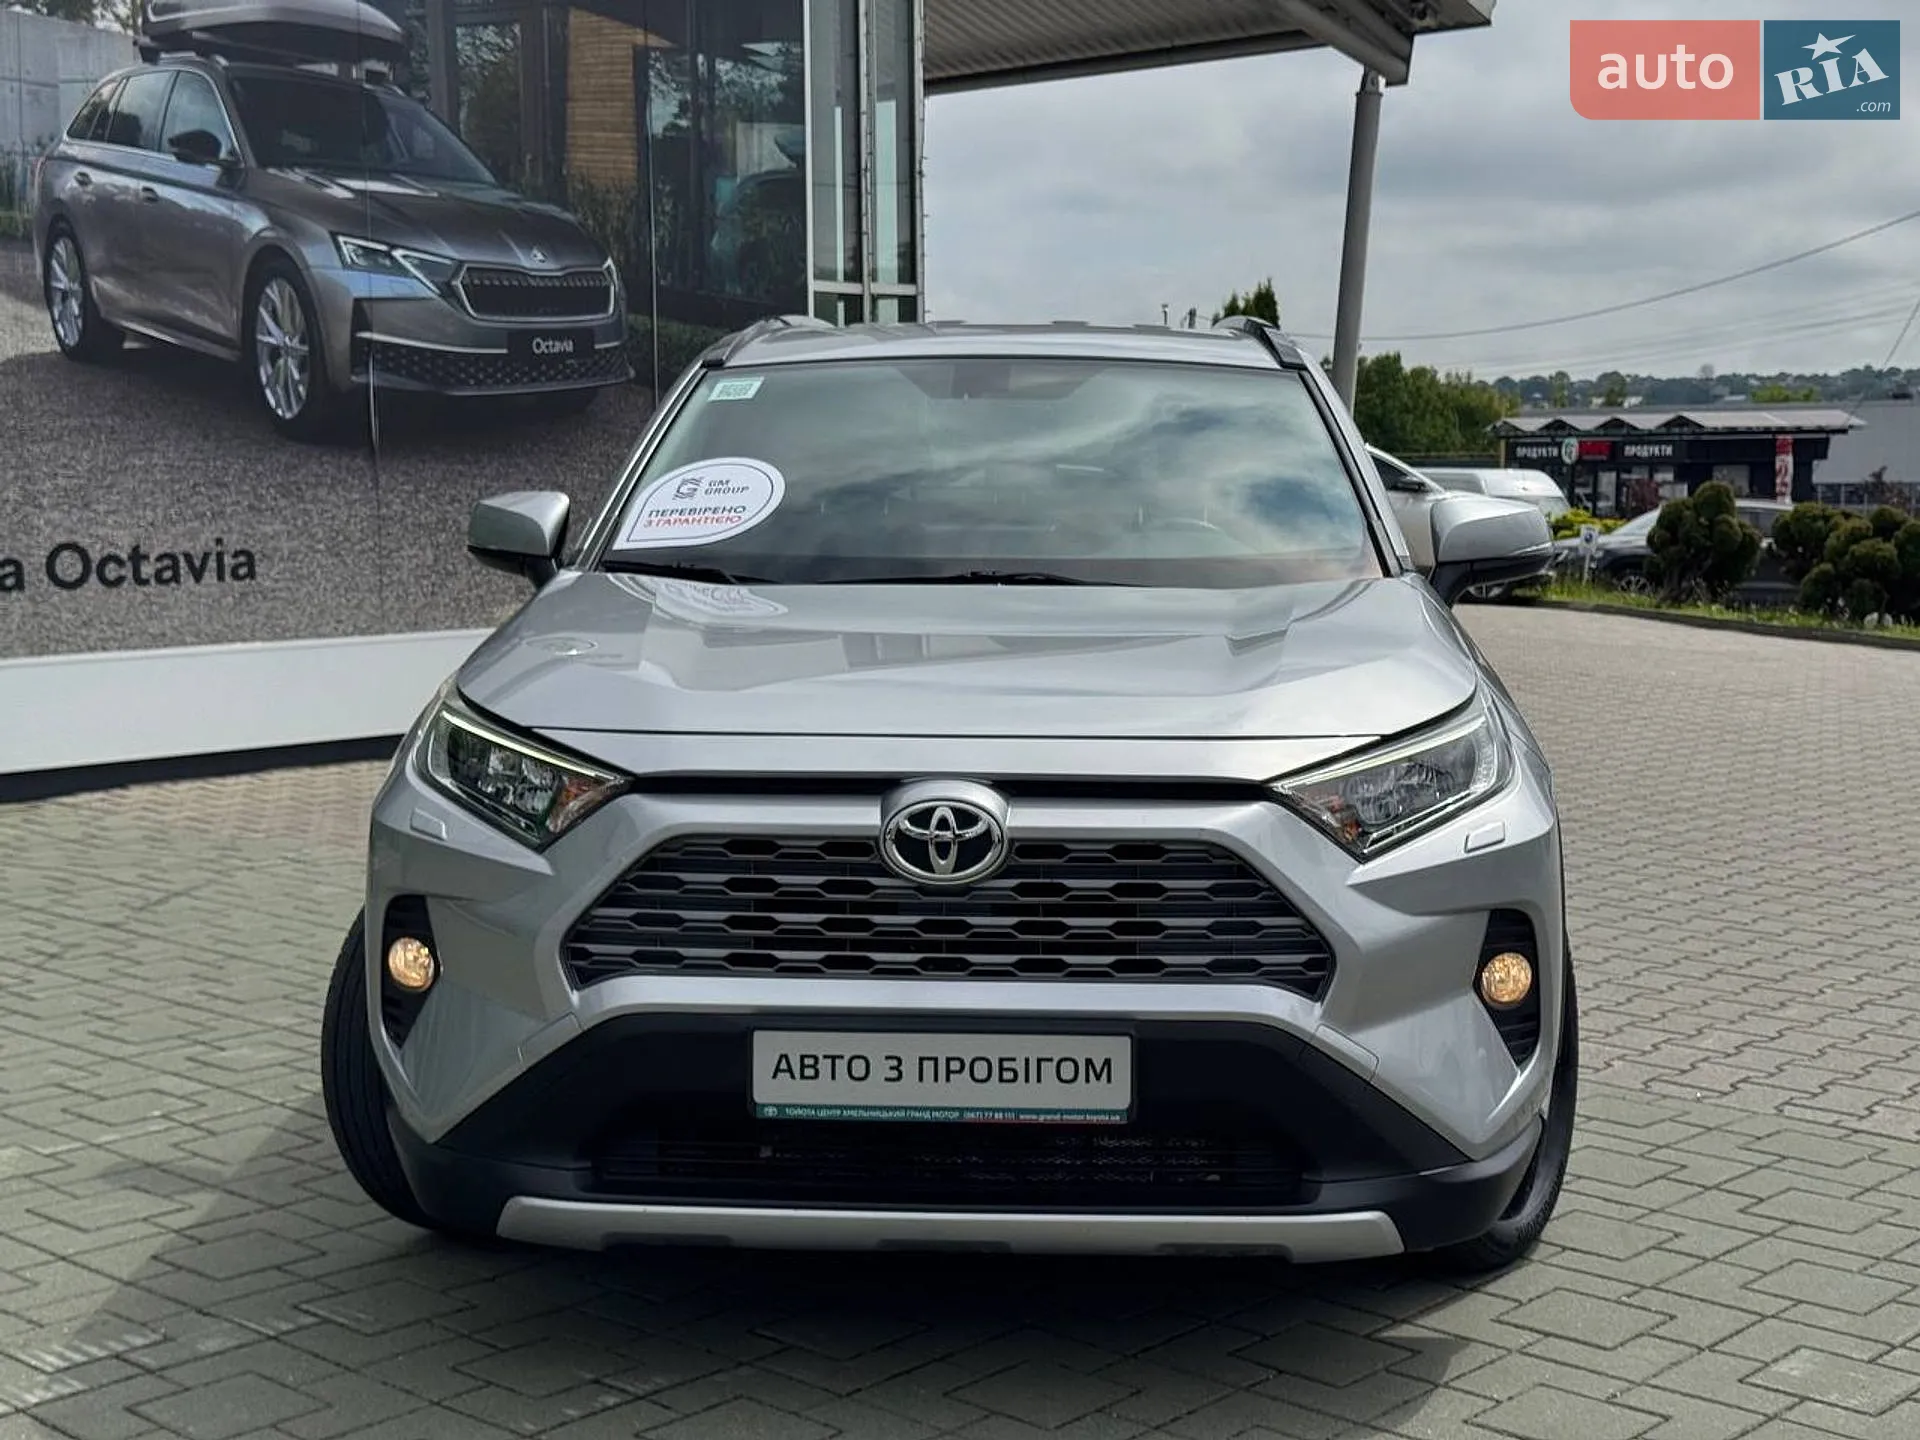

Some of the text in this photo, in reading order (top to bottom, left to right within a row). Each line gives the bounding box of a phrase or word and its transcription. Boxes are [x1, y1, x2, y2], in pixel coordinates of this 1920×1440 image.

[532, 337, 574, 354] Octavia
[1516, 447, 1559, 458] ПРОДУКТИ
[1624, 444, 1673, 457] ПРОДУКТИ
[704, 486, 750, 496] GROUP
[649, 505, 747, 518] ПЕРЕВІРЕНО
[46, 537, 256, 590] Octavia
[771, 1053, 872, 1082] АВТО
[918, 1056, 1113, 1085] ПРОБІГОМ
